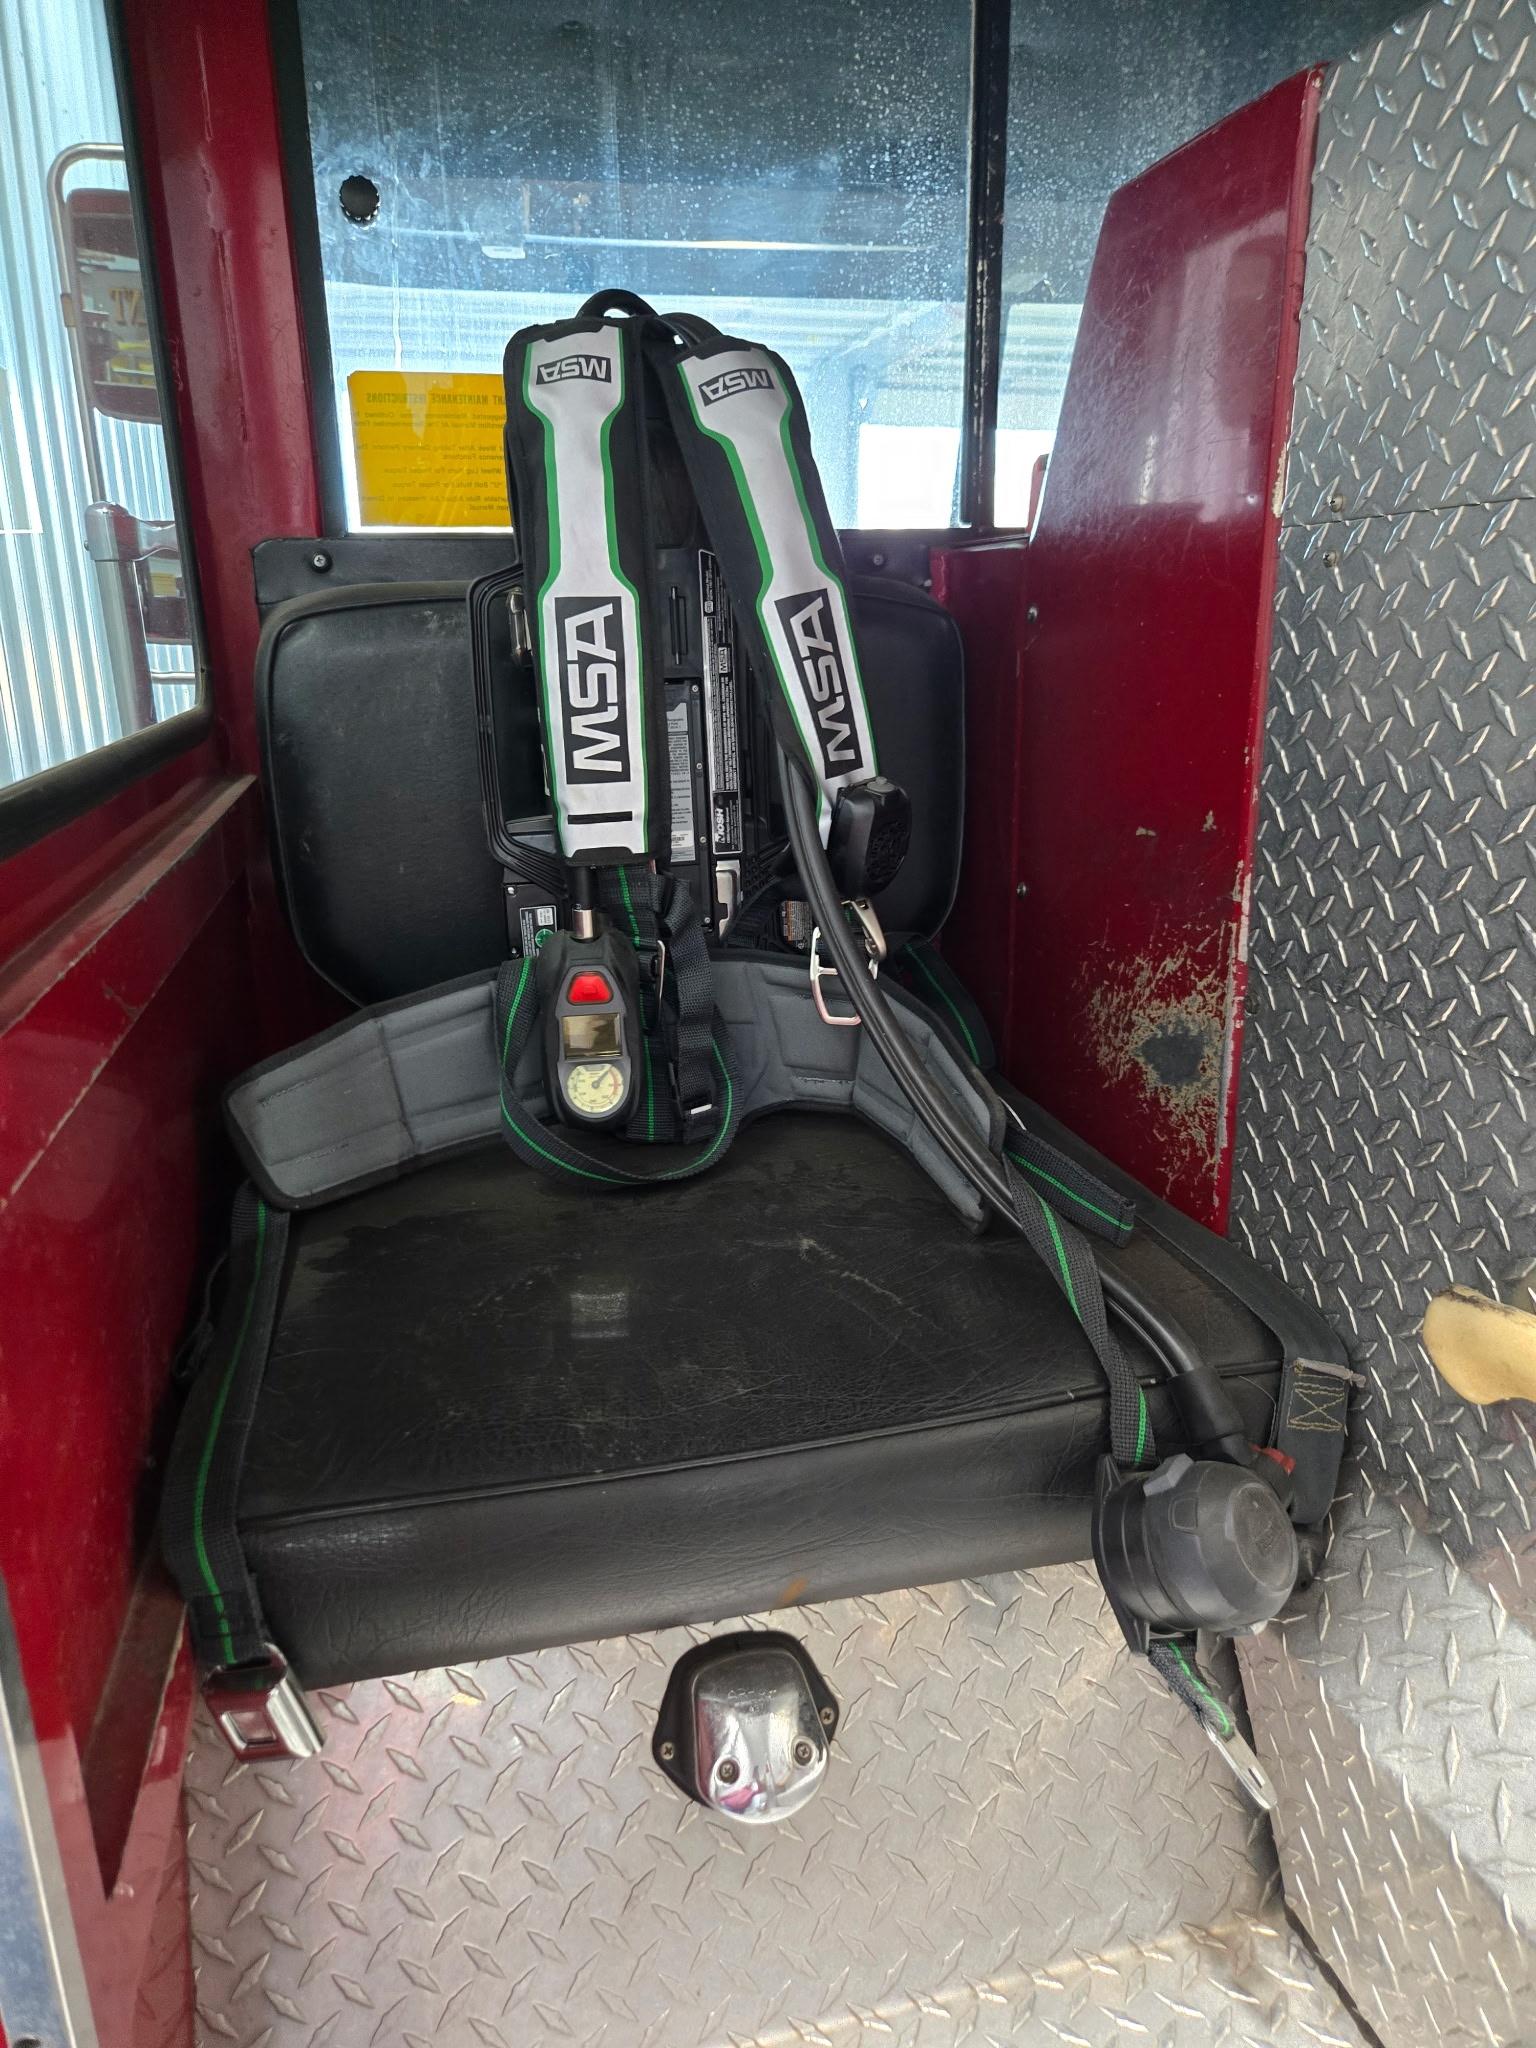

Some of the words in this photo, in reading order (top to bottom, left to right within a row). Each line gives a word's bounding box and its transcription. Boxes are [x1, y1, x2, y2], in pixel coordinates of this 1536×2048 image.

[540, 357, 607, 382] MSA
[701, 370, 769, 401] MSA
[718, 647, 729, 673] MSA
[564, 602, 623, 773] MSA
[789, 596, 856, 762] MSA
[714, 807, 726, 844] NIOSH
